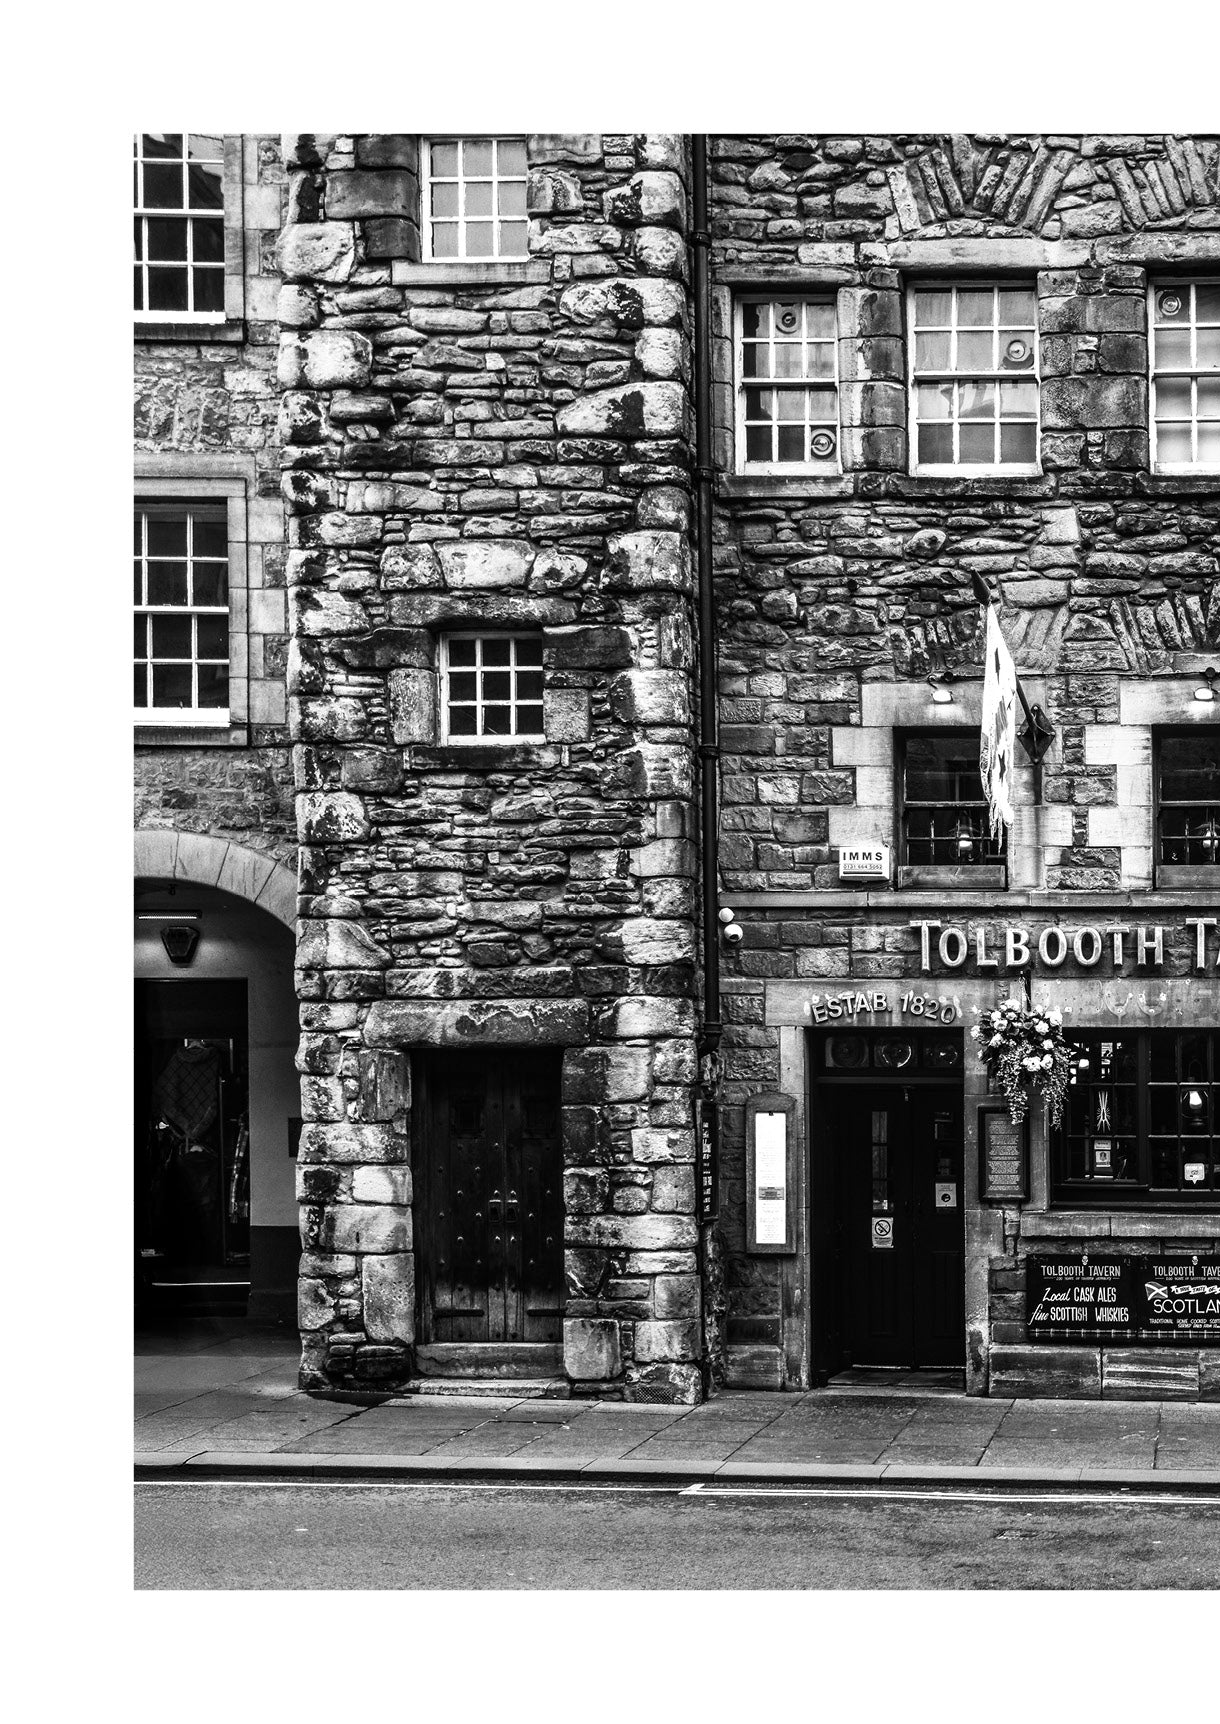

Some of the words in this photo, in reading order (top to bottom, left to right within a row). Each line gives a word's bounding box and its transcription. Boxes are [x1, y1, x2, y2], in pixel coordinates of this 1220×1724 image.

[843, 852, 882, 861] IMMS
[909, 919, 1164, 971] TOLBOOTH
[812, 991, 892, 1023] ESTAB.
[901, 992, 956, 1024] 1820
[1041, 1265, 1084, 1276] TOLBOOTH
[1088, 1265, 1120, 1276] TAVERN
[1153, 1265, 1195, 1276] TOLBOOTH
[1042, 1287, 1071, 1302] Local
[1073, 1287, 1095, 1302] CASK
[1097, 1287, 1117, 1302] ALES
[1050, 1306, 1088, 1321] SCOTTISH
[1094, 1306, 1129, 1322] WHISKIES
